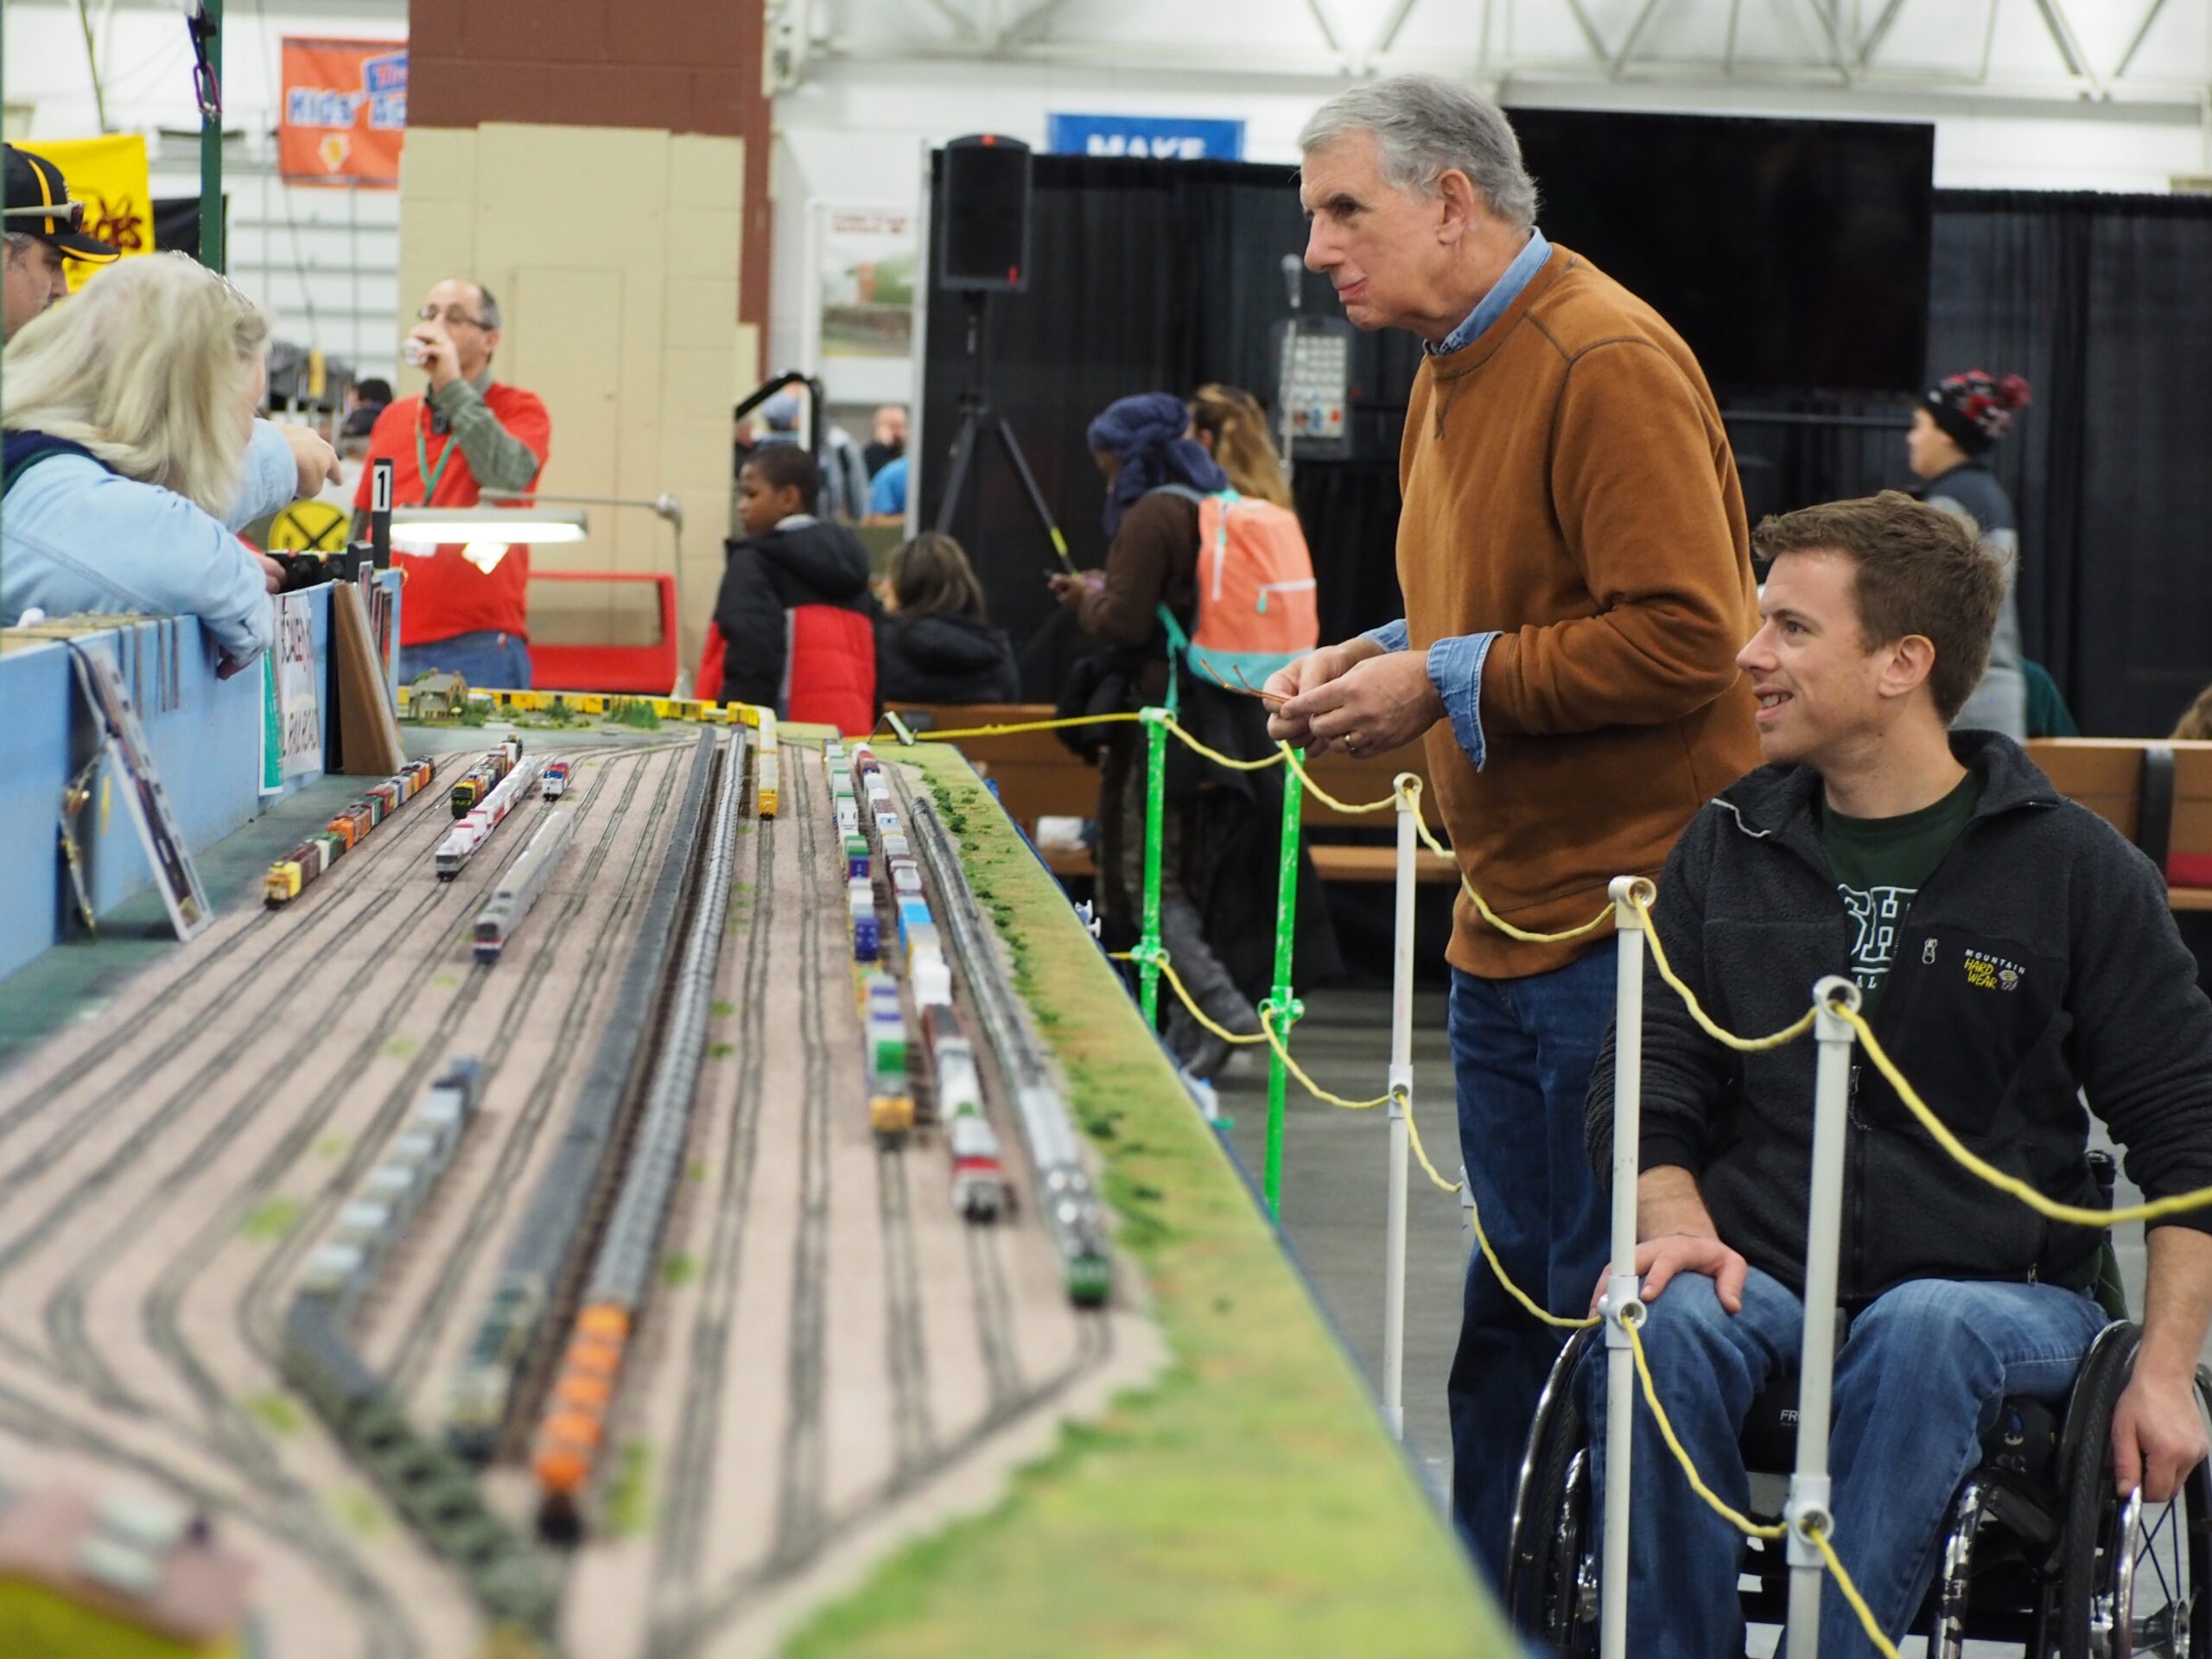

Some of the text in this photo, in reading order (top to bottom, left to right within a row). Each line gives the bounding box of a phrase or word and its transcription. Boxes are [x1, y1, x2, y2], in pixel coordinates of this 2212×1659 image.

[1086, 134, 1206, 159] MAKE
[378, 471, 385, 507] 1
[1964, 957, 1994, 975] HARD
[1965, 948, 2026, 975] MOUNTAIN
[1967, 970, 1998, 989] WEAR
